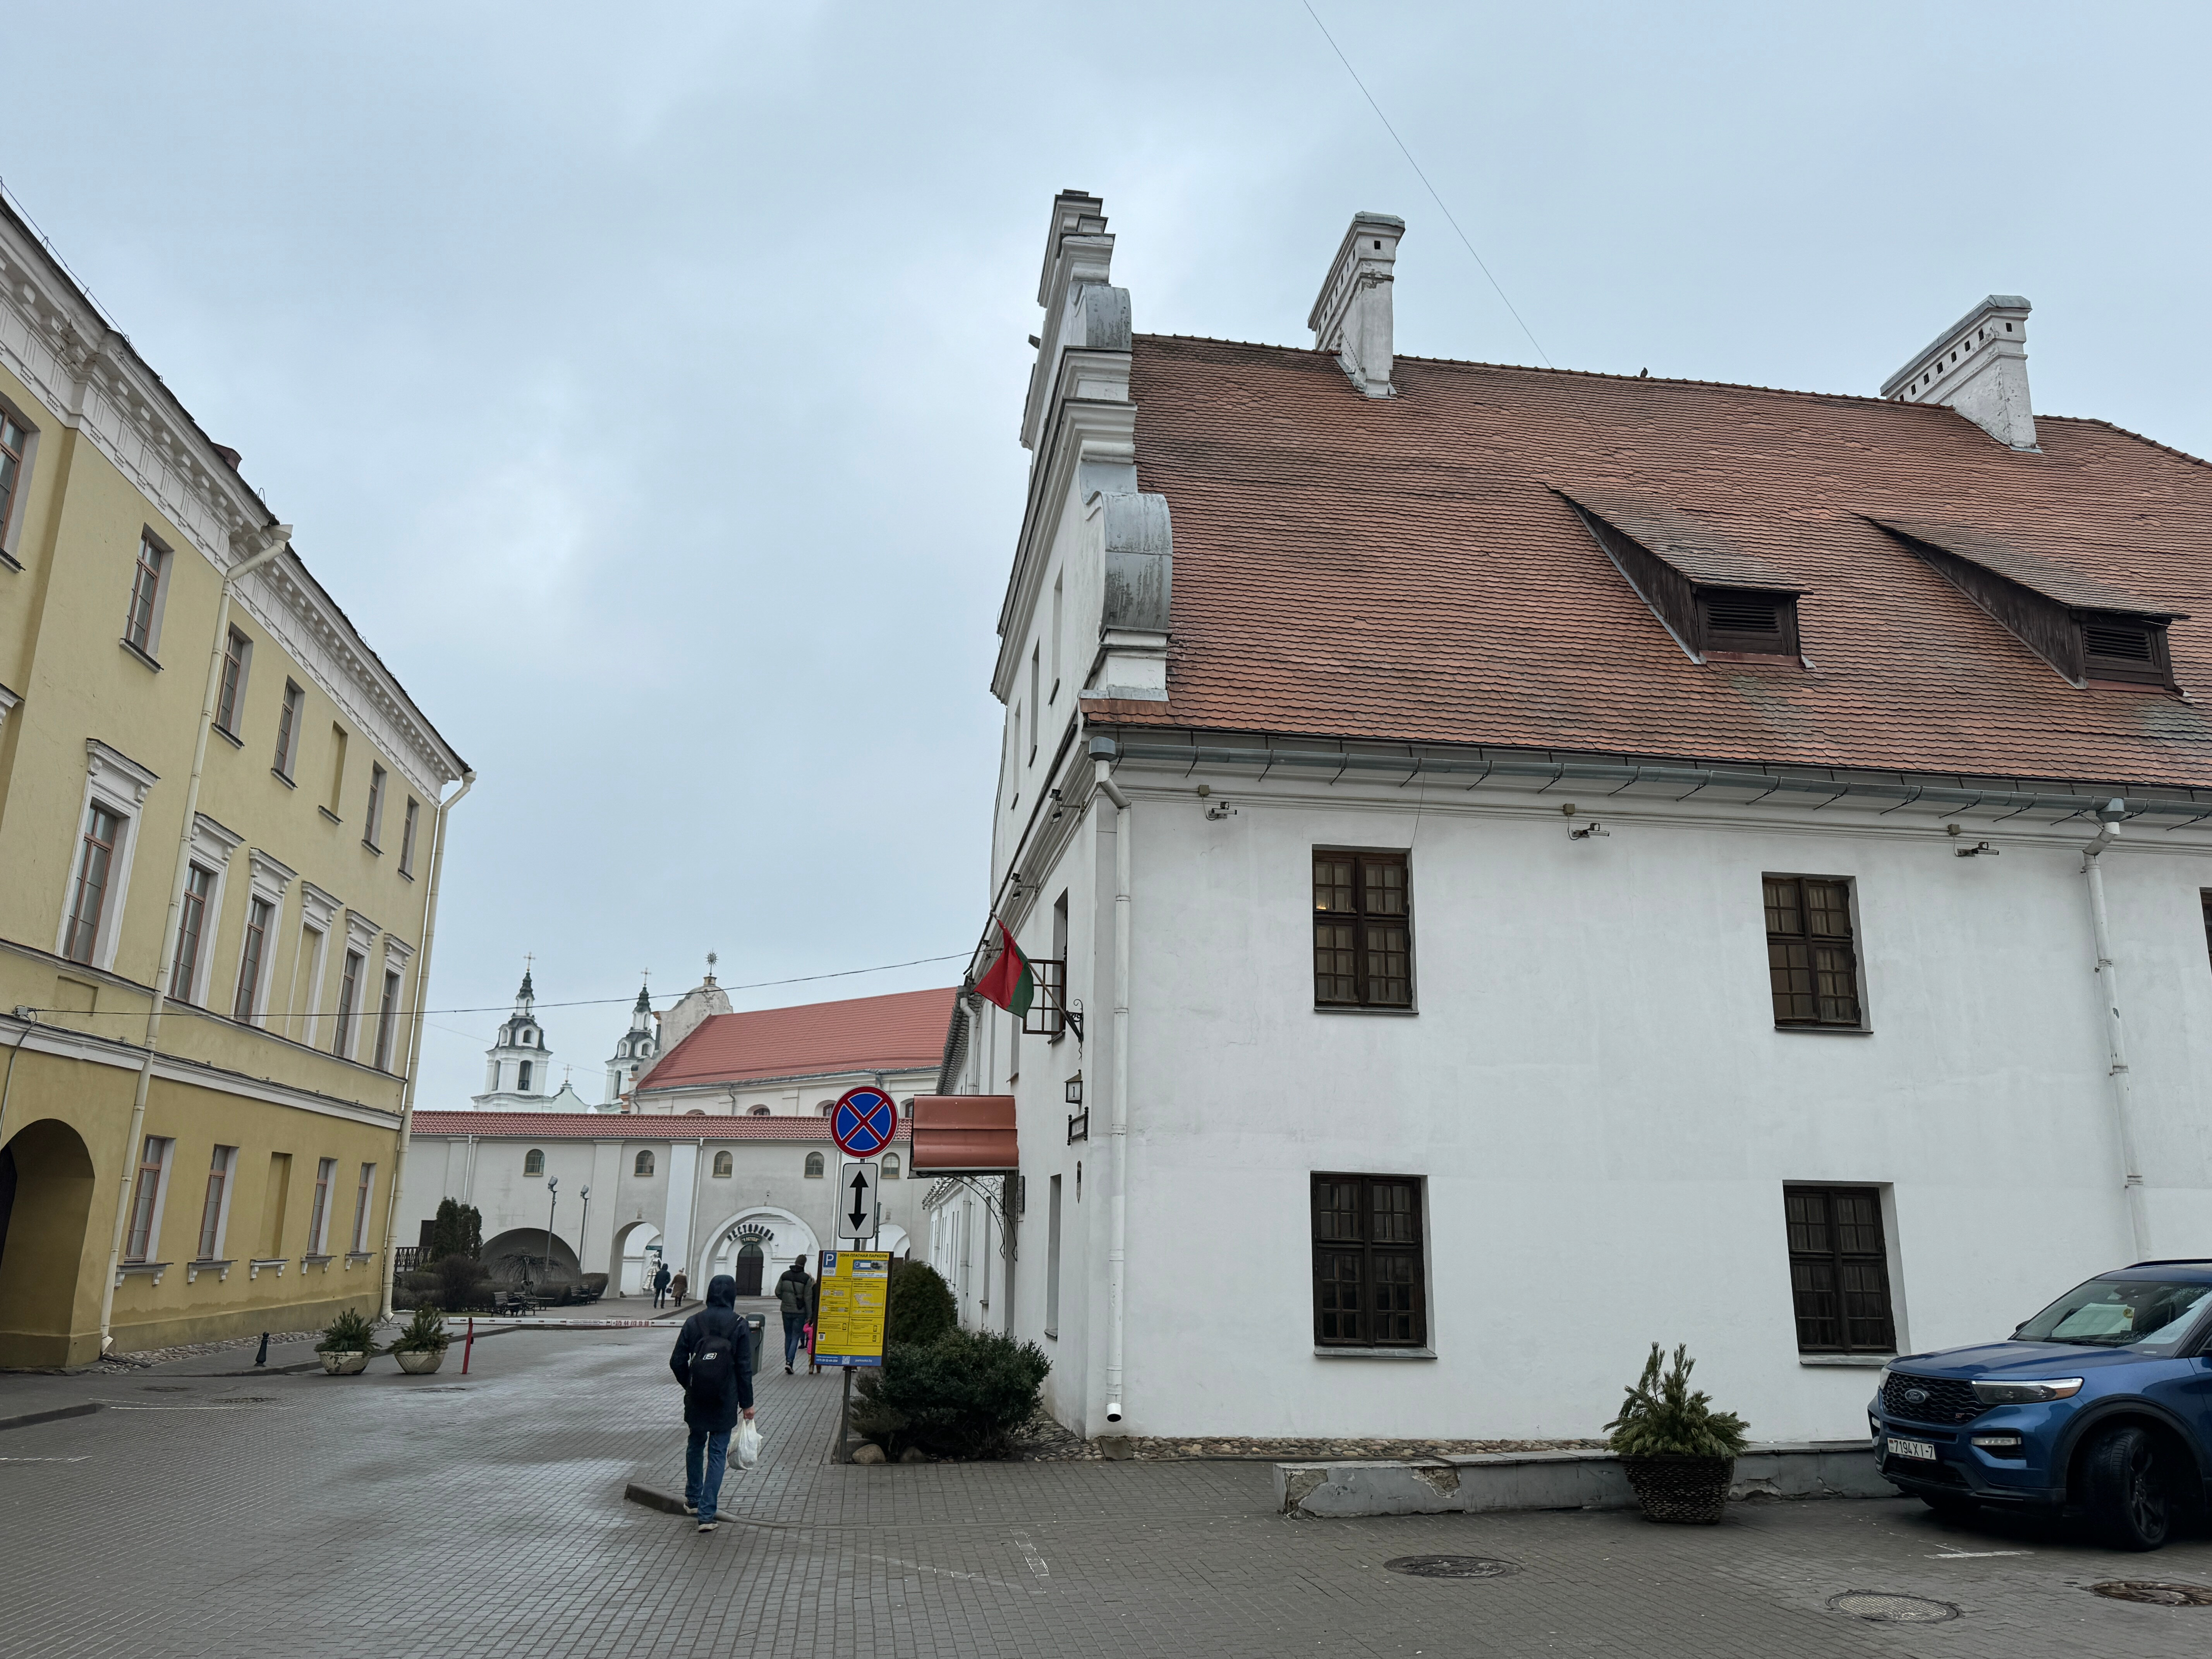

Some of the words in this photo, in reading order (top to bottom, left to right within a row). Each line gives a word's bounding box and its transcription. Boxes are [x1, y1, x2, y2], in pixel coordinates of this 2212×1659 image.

[1072, 1086, 1076, 1097] 1
[826, 1254, 834, 1266] P
[1909, 1392, 1920, 1400] Ford
